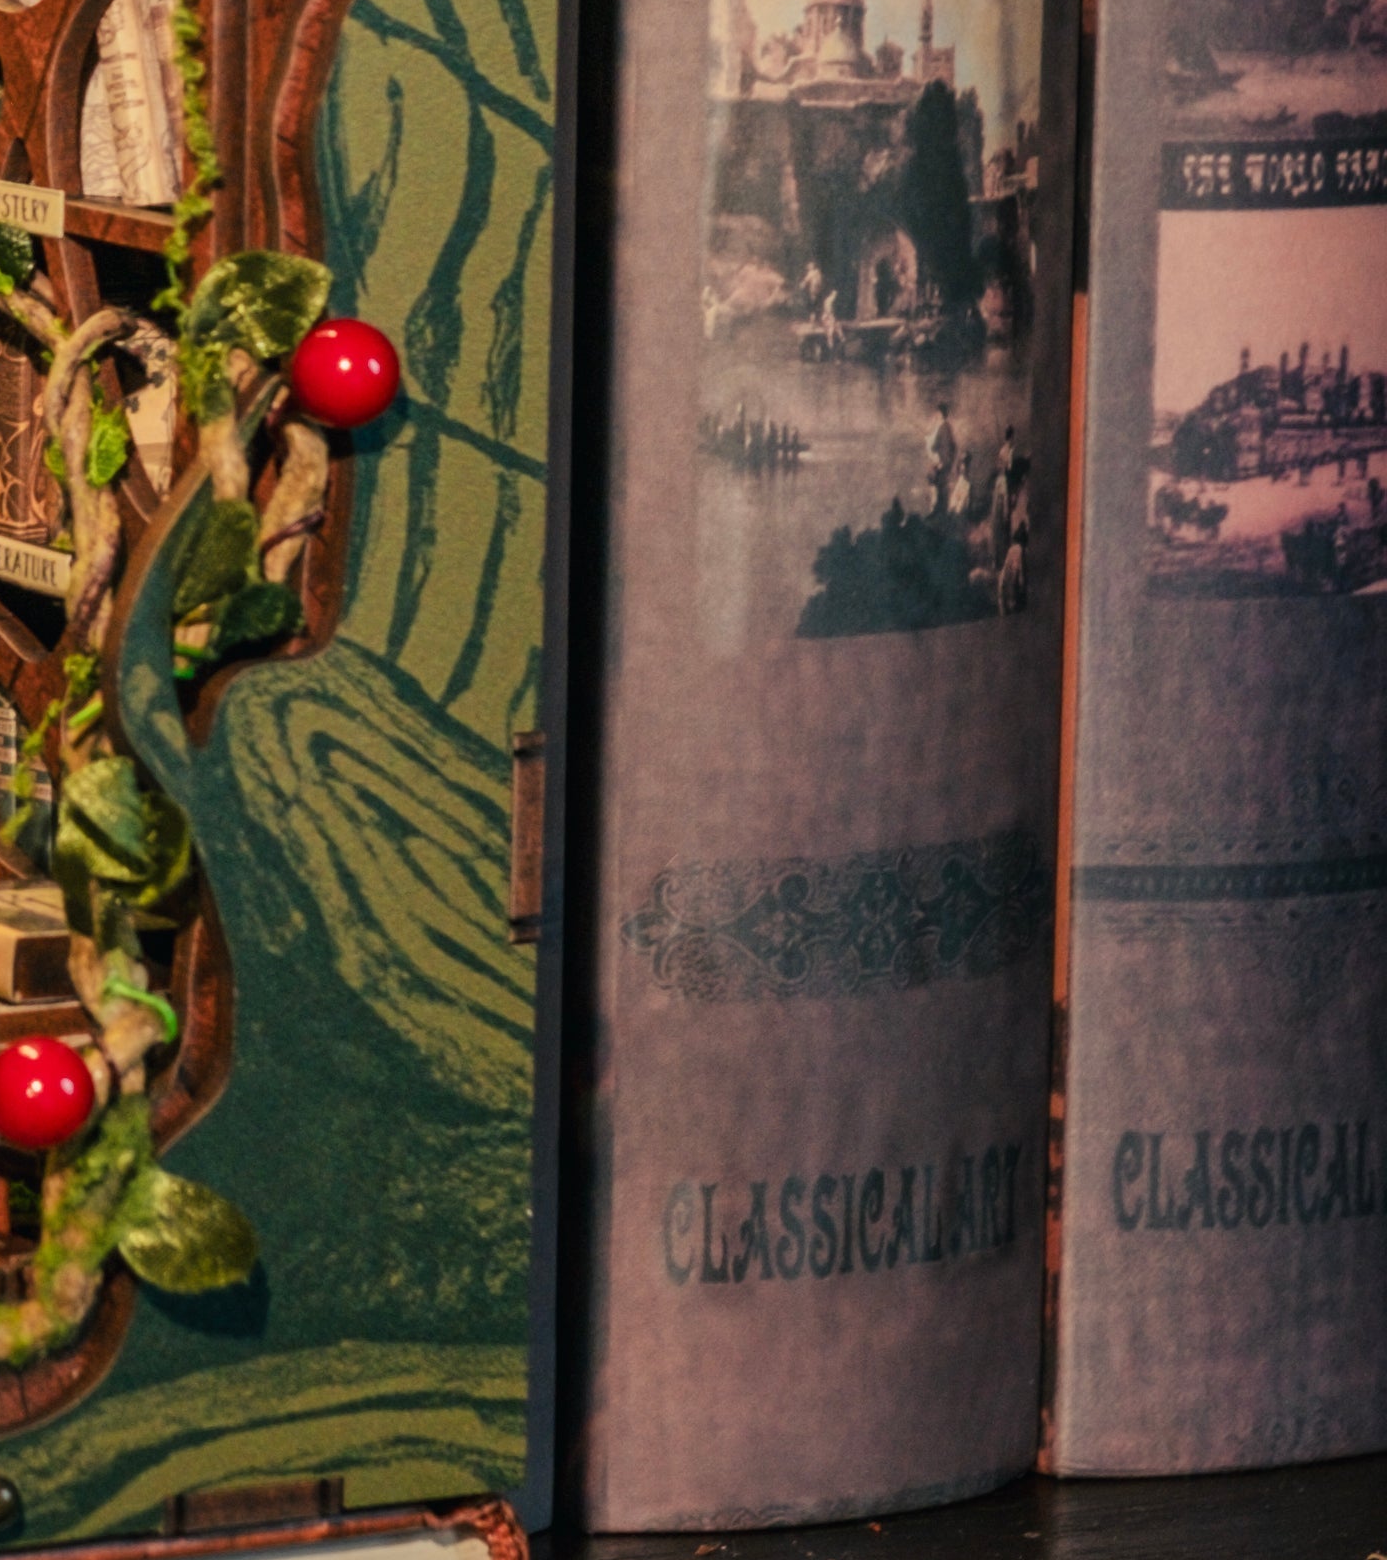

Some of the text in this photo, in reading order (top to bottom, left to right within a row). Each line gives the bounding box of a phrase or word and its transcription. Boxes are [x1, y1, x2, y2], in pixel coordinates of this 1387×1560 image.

[660, 1142, 1023, 1287] CLASSICAL ART
[1113, 1121, 1375, 1231] CLASSICAL
